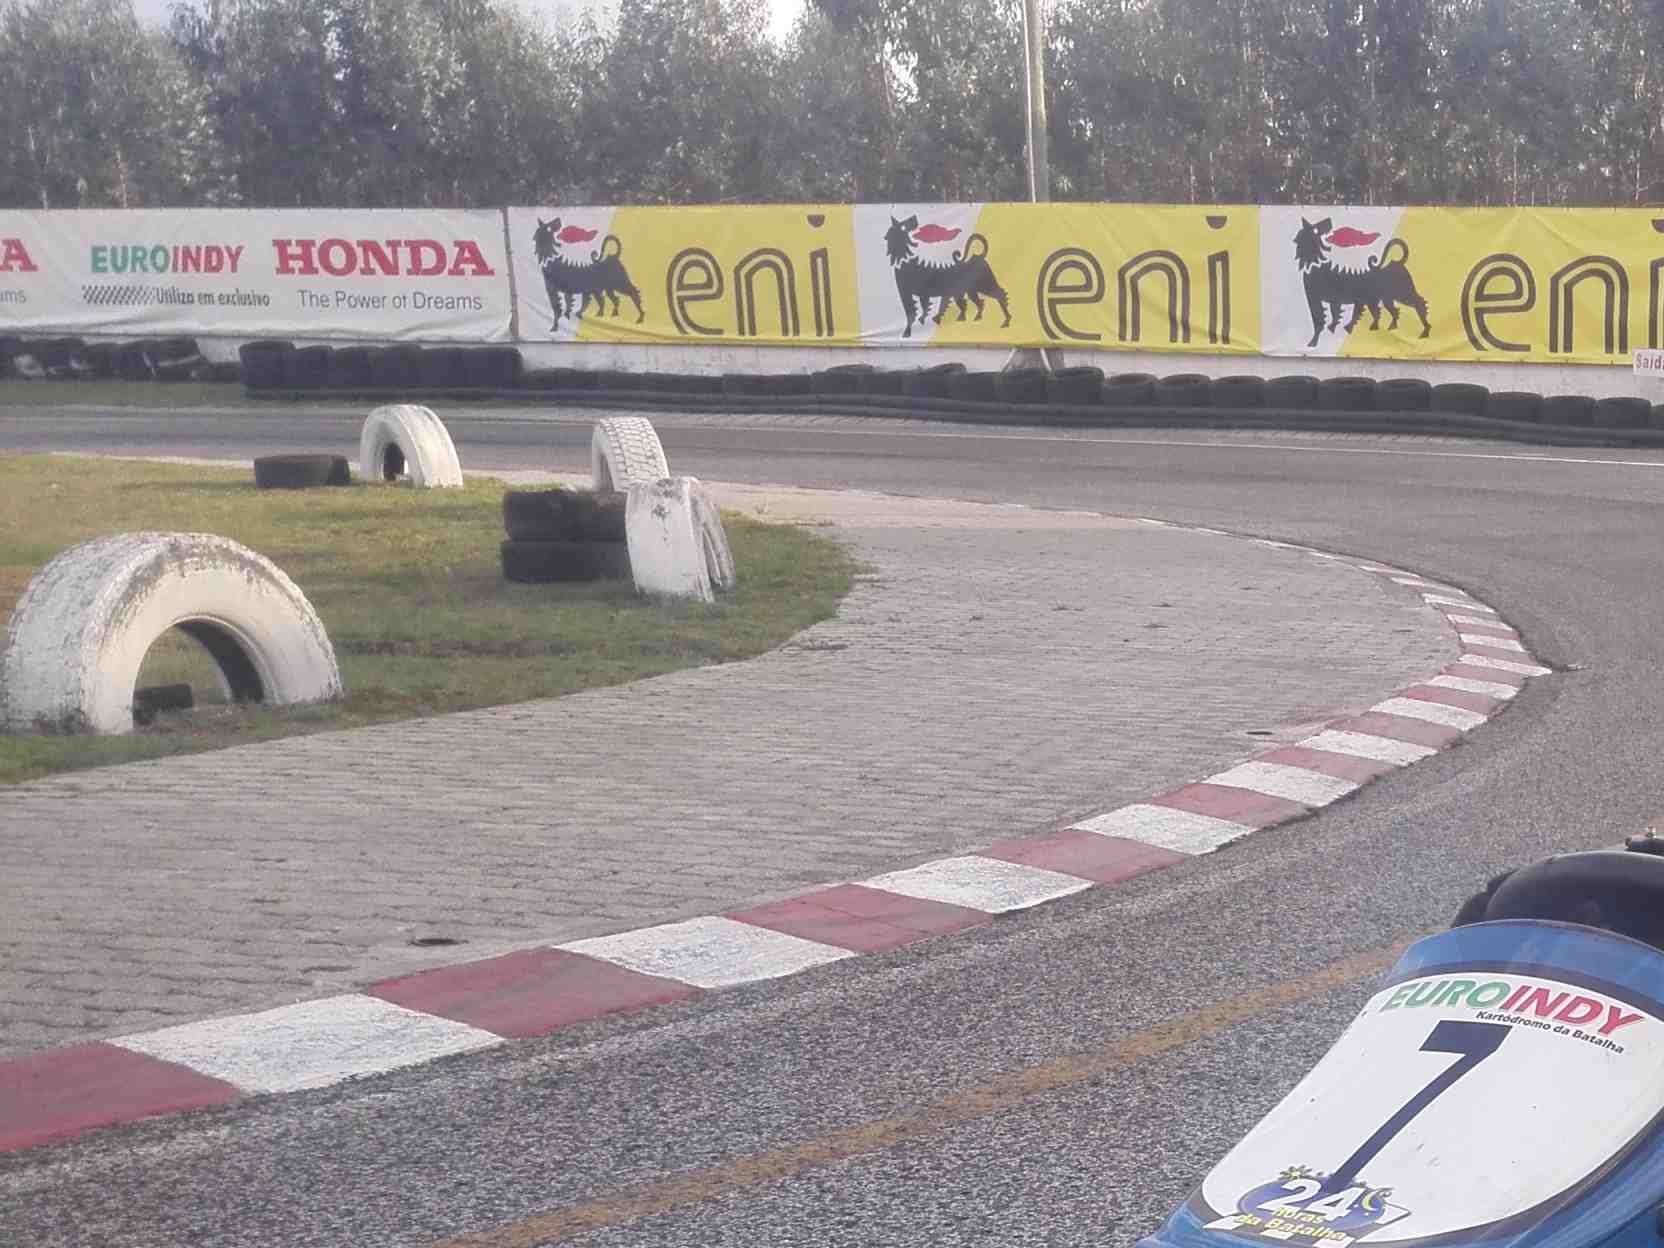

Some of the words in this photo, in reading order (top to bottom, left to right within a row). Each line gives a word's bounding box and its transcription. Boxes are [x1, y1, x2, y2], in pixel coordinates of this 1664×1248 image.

[91, 245, 244, 274] EUROINDY
[272, 239, 495, 276] HONDA
[666, 213, 834, 338] eni
[198, 292, 215, 306] em
[1037, 214, 1231, 345] eni
[299, 290, 331, 309] The
[336, 290, 386, 310] Power
[391, 289, 408, 310] of
[412, 291, 483, 311] Dreams
[1380, 979, 1645, 1037] EUROINDY
[1553, 1025, 1571, 1036] da
[1573, 1029, 1624, 1054] Batalha
[1328, 1020, 1513, 1192] 7
[1256, 1177, 1366, 1221] 24
